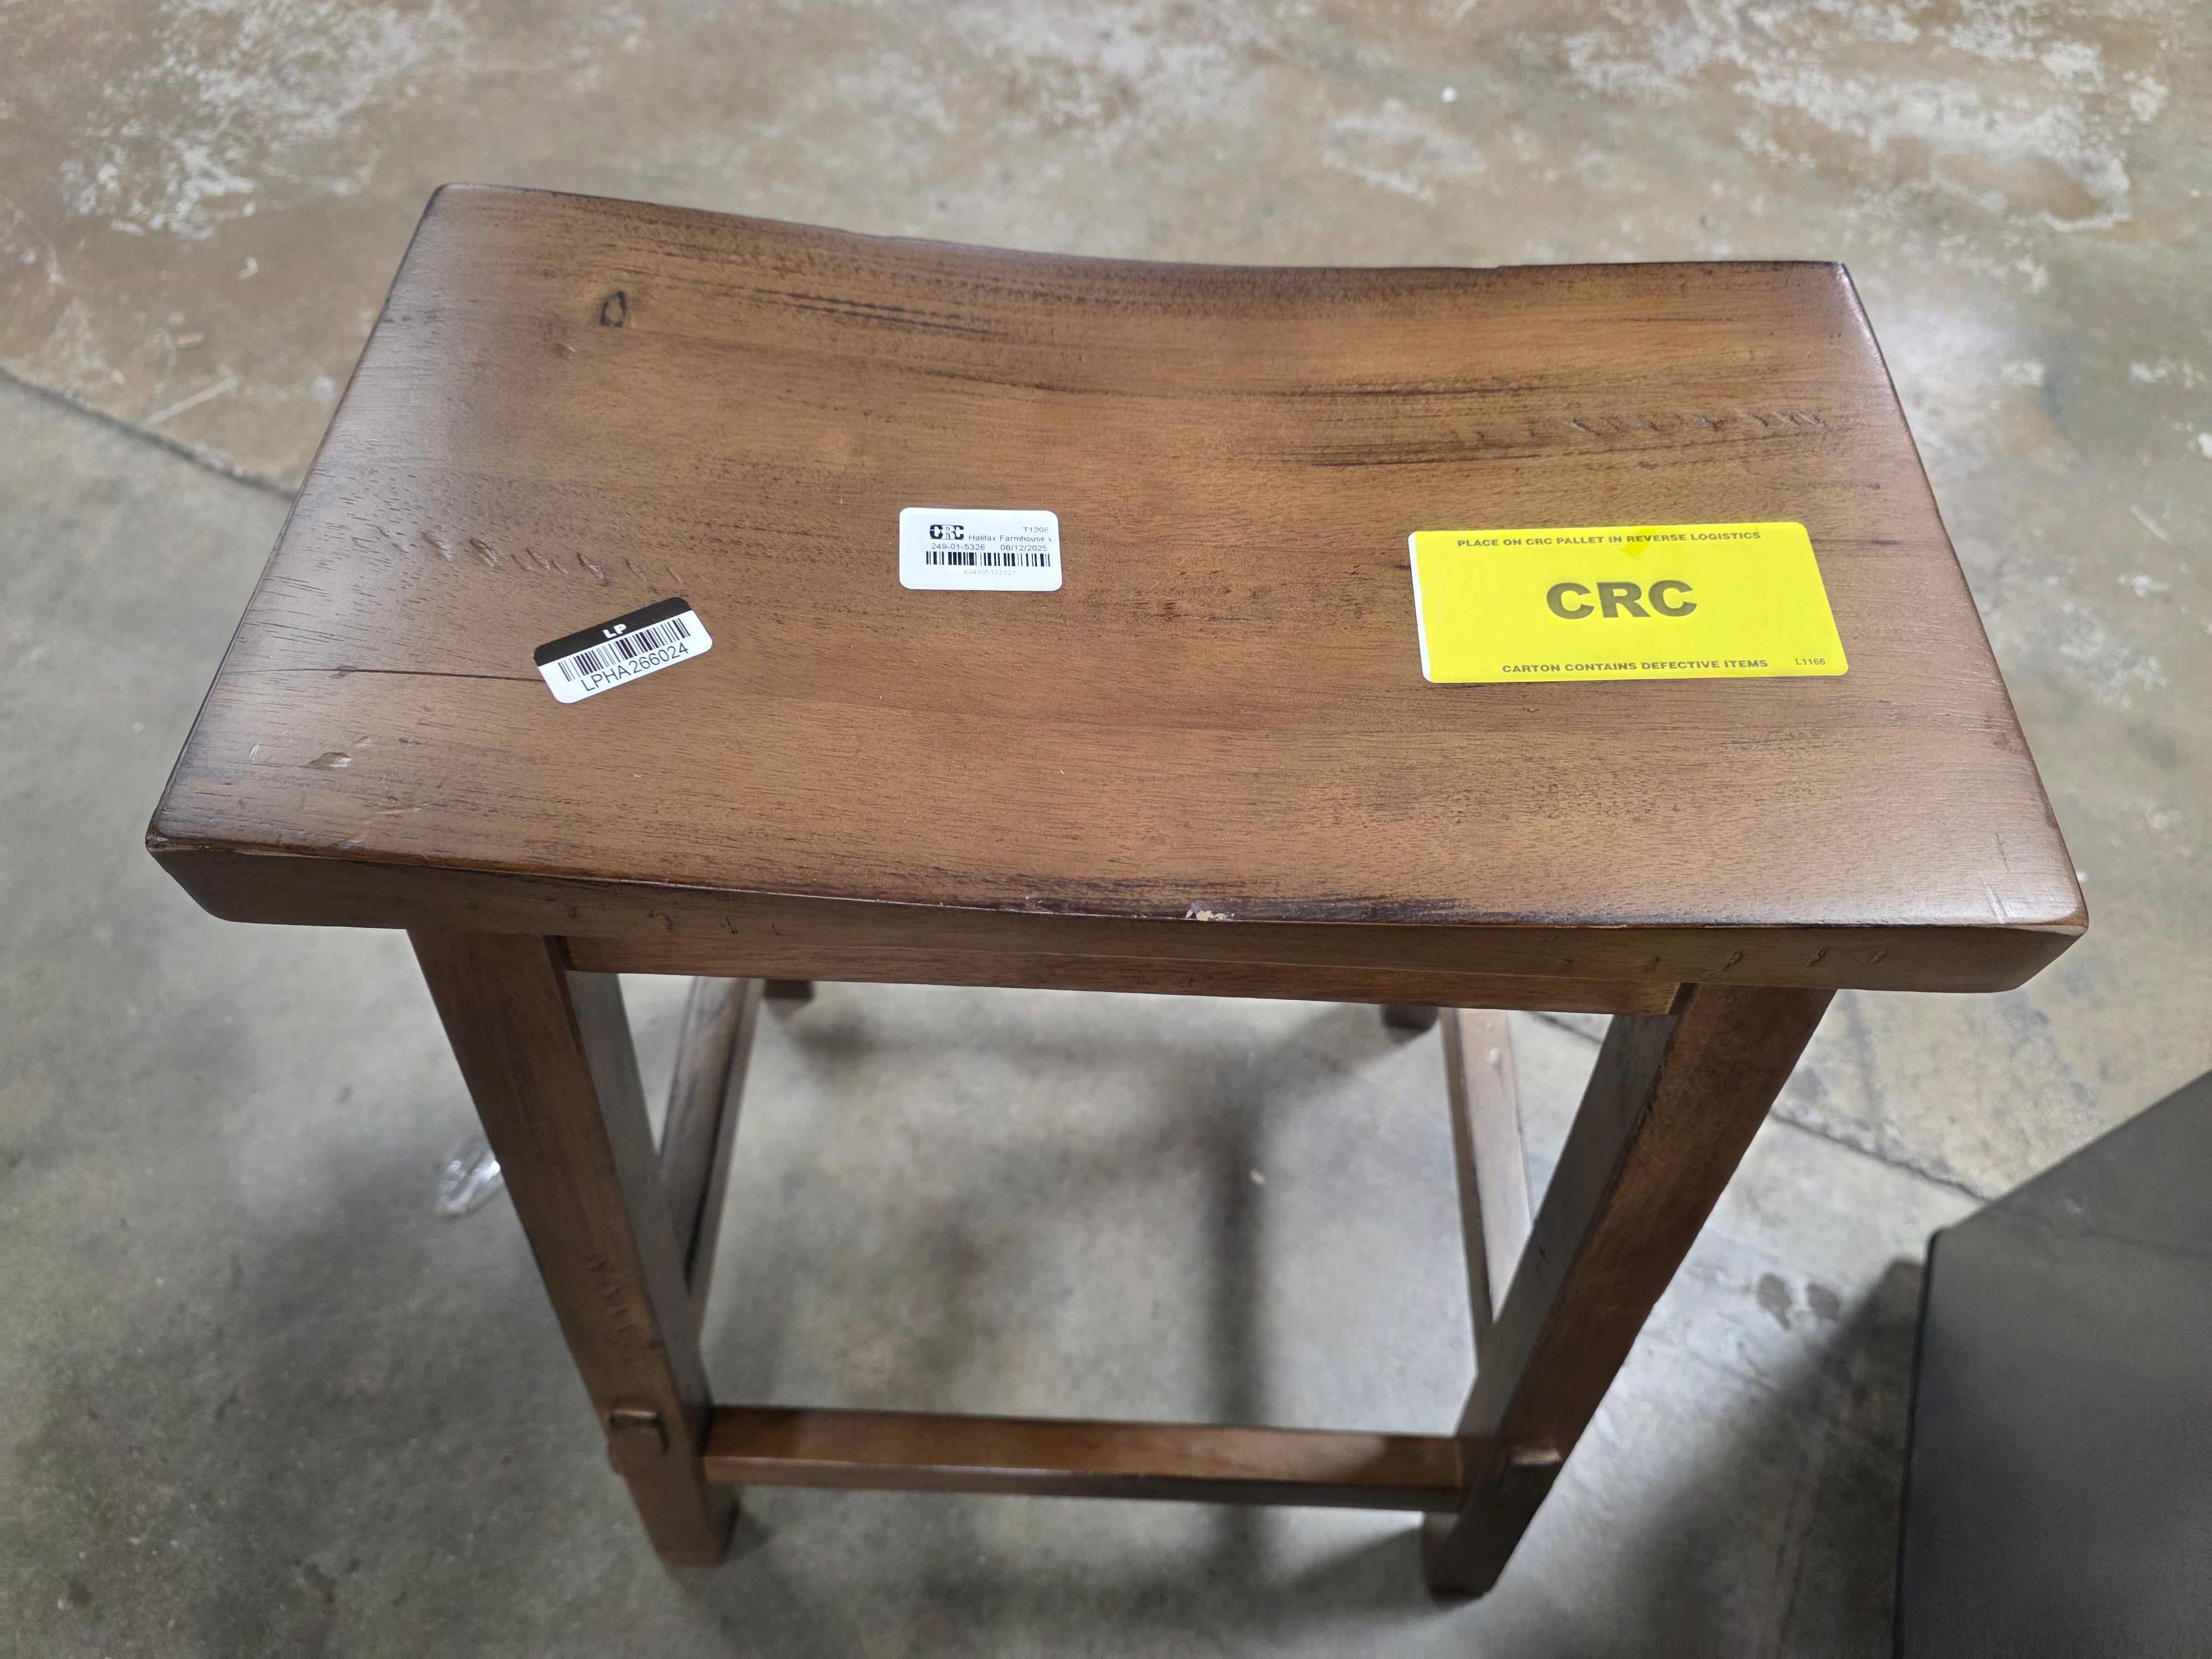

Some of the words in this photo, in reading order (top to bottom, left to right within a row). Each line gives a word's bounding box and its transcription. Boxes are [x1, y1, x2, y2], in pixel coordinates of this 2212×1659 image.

[930, 524, 964, 540] CRC
[1457, 539, 1499, 547] PLACE
[1556, 536, 1604, 545] PALLET
[1626, 534, 1687, 542] REVERSE
[1690, 531, 1761, 541] LOGISTICS
[1546, 578, 1698, 620] CRC
[603, 623, 627, 639] LP
[581, 641, 689, 692] LPHA266024
[1502, 664, 1561, 672] CARTON
[1564, 662, 1637, 671] CONTAINS
[1641, 660, 1720, 670] DEFECTIVE
[1724, 659, 1768, 668] ITEMS
[1794, 658, 1826, 666] L1166
